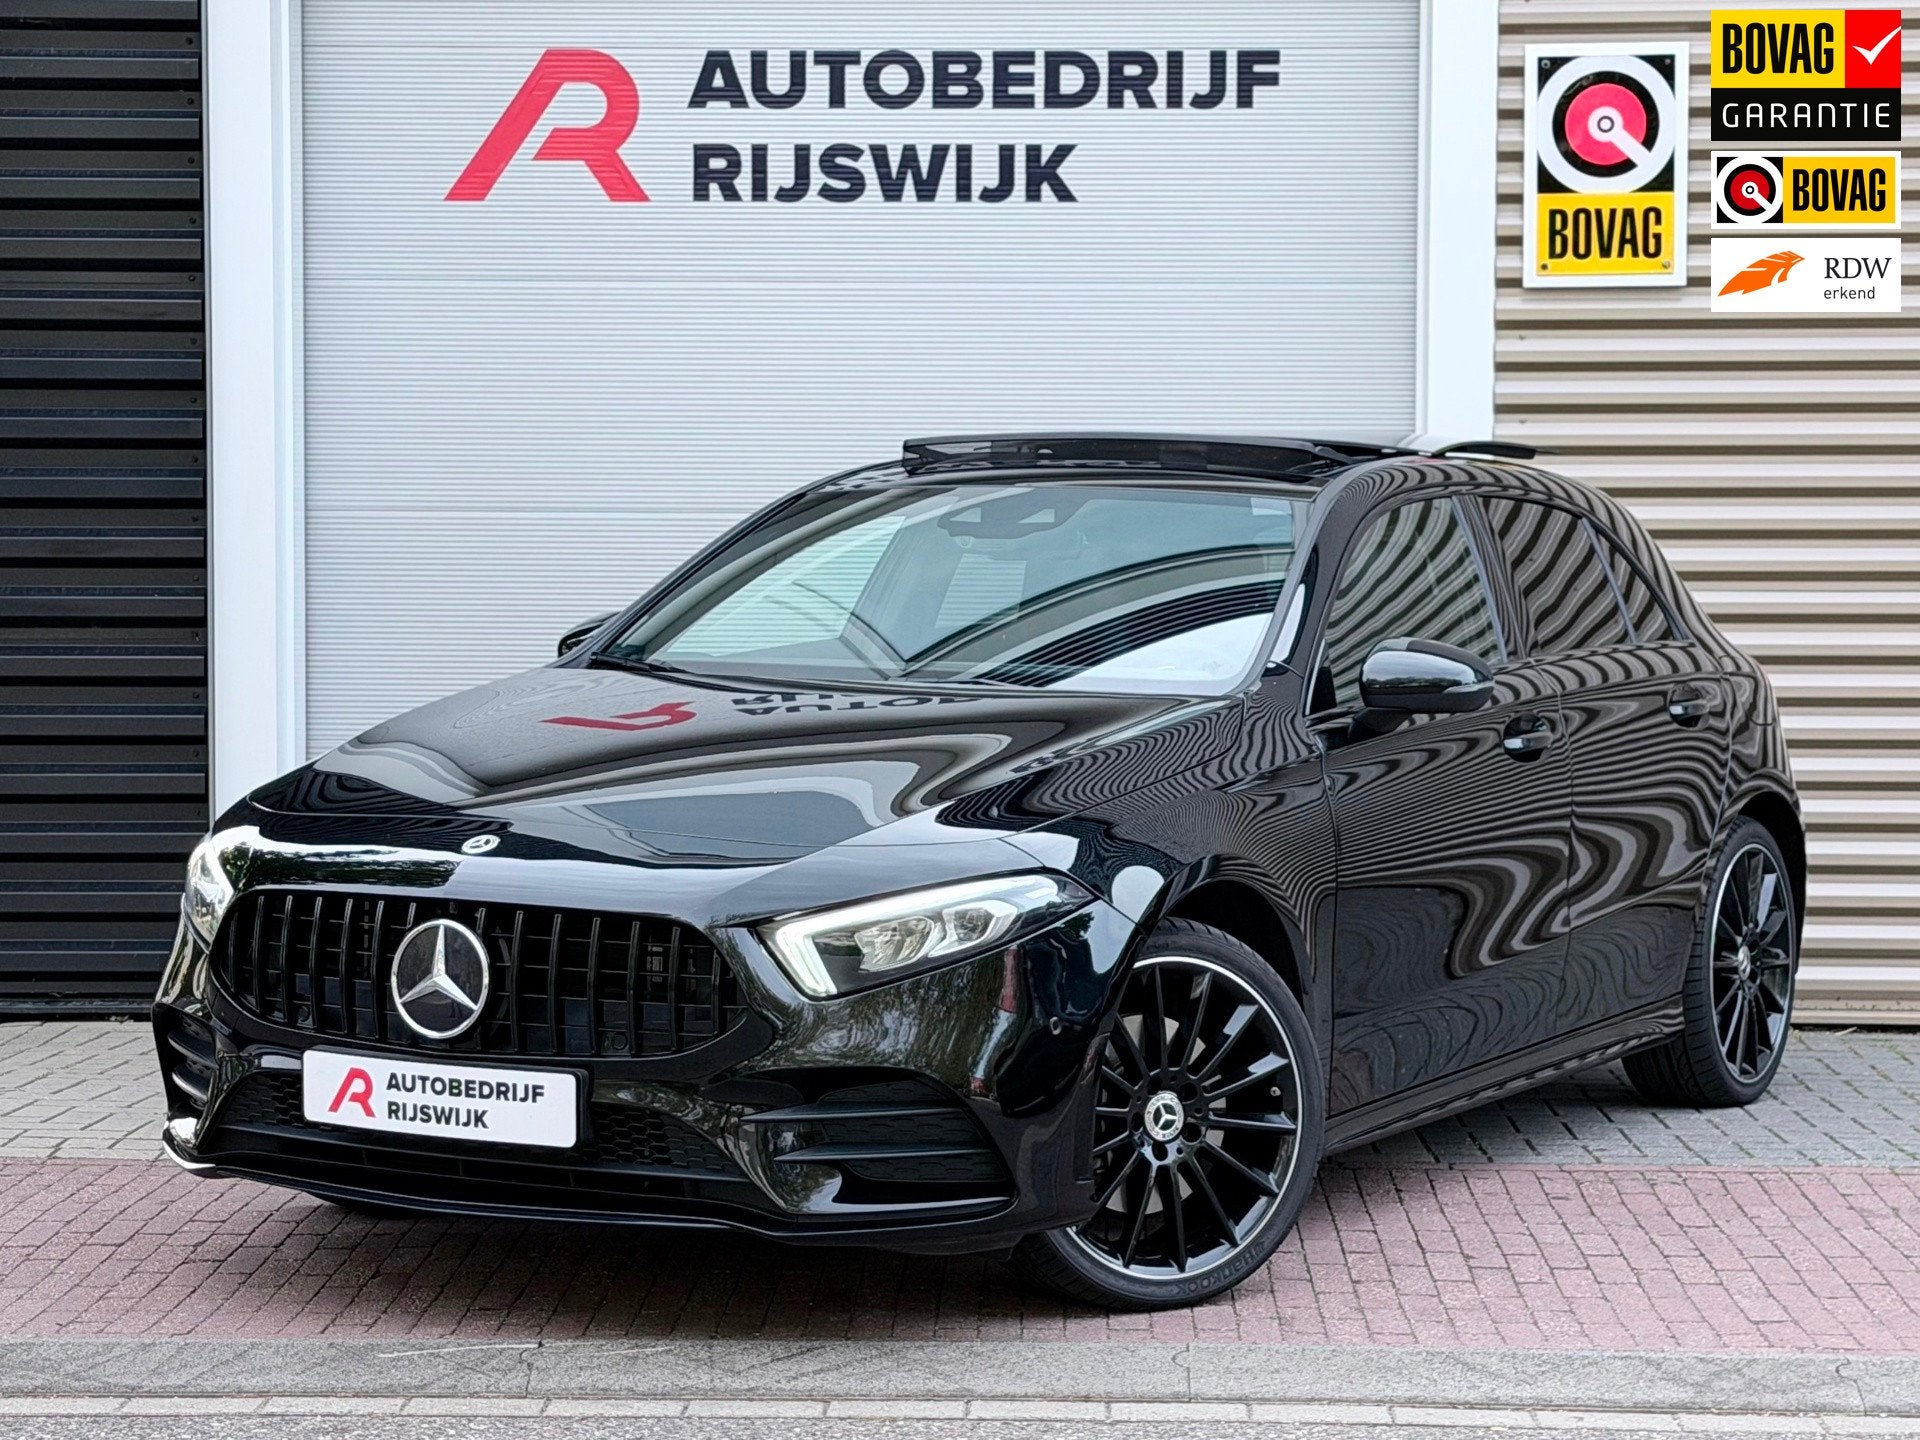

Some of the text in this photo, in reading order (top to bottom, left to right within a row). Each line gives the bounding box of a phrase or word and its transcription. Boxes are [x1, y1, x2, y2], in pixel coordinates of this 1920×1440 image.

[688, 49, 1281, 110] AUTOBEDRIJF
[692, 144, 1078, 203] RIJSWIJK
[1548, 205, 1662, 260] BOVAG
[386, 1072, 546, 1104] AUTOBEDRIJF
[387, 1101, 489, 1129] RIJSWIJK
